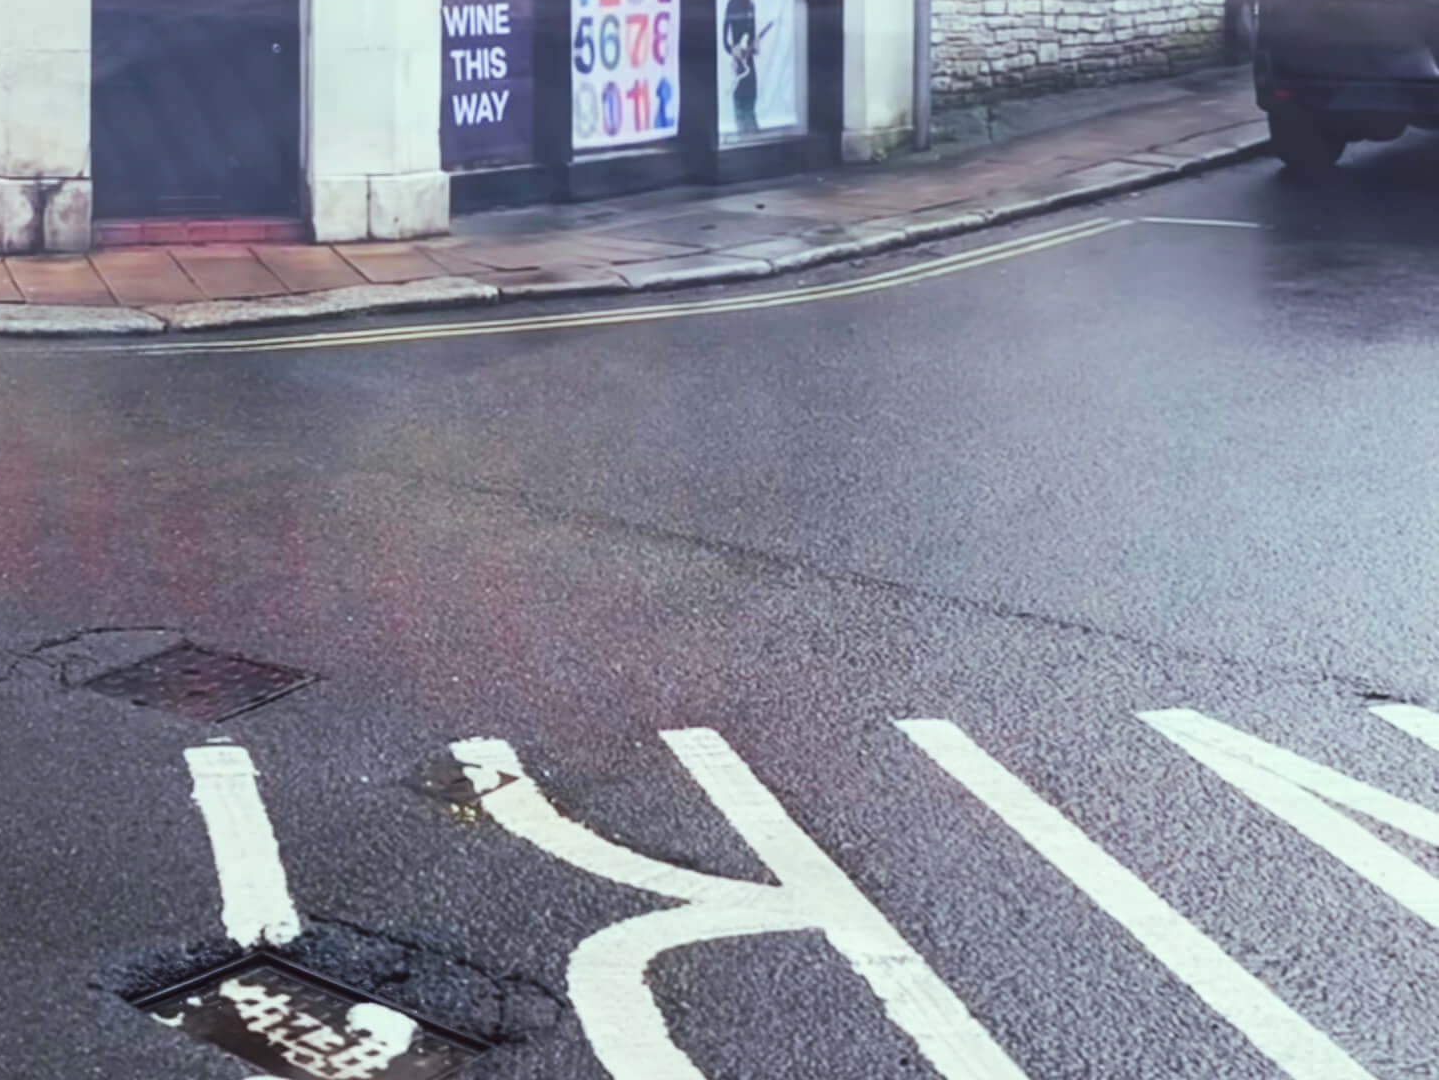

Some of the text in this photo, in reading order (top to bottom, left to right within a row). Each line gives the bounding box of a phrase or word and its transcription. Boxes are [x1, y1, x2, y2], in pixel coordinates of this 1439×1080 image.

[442, 3, 511, 37] WINE
[450, 46, 507, 81] THIS
[452, 90, 510, 126] WAY
